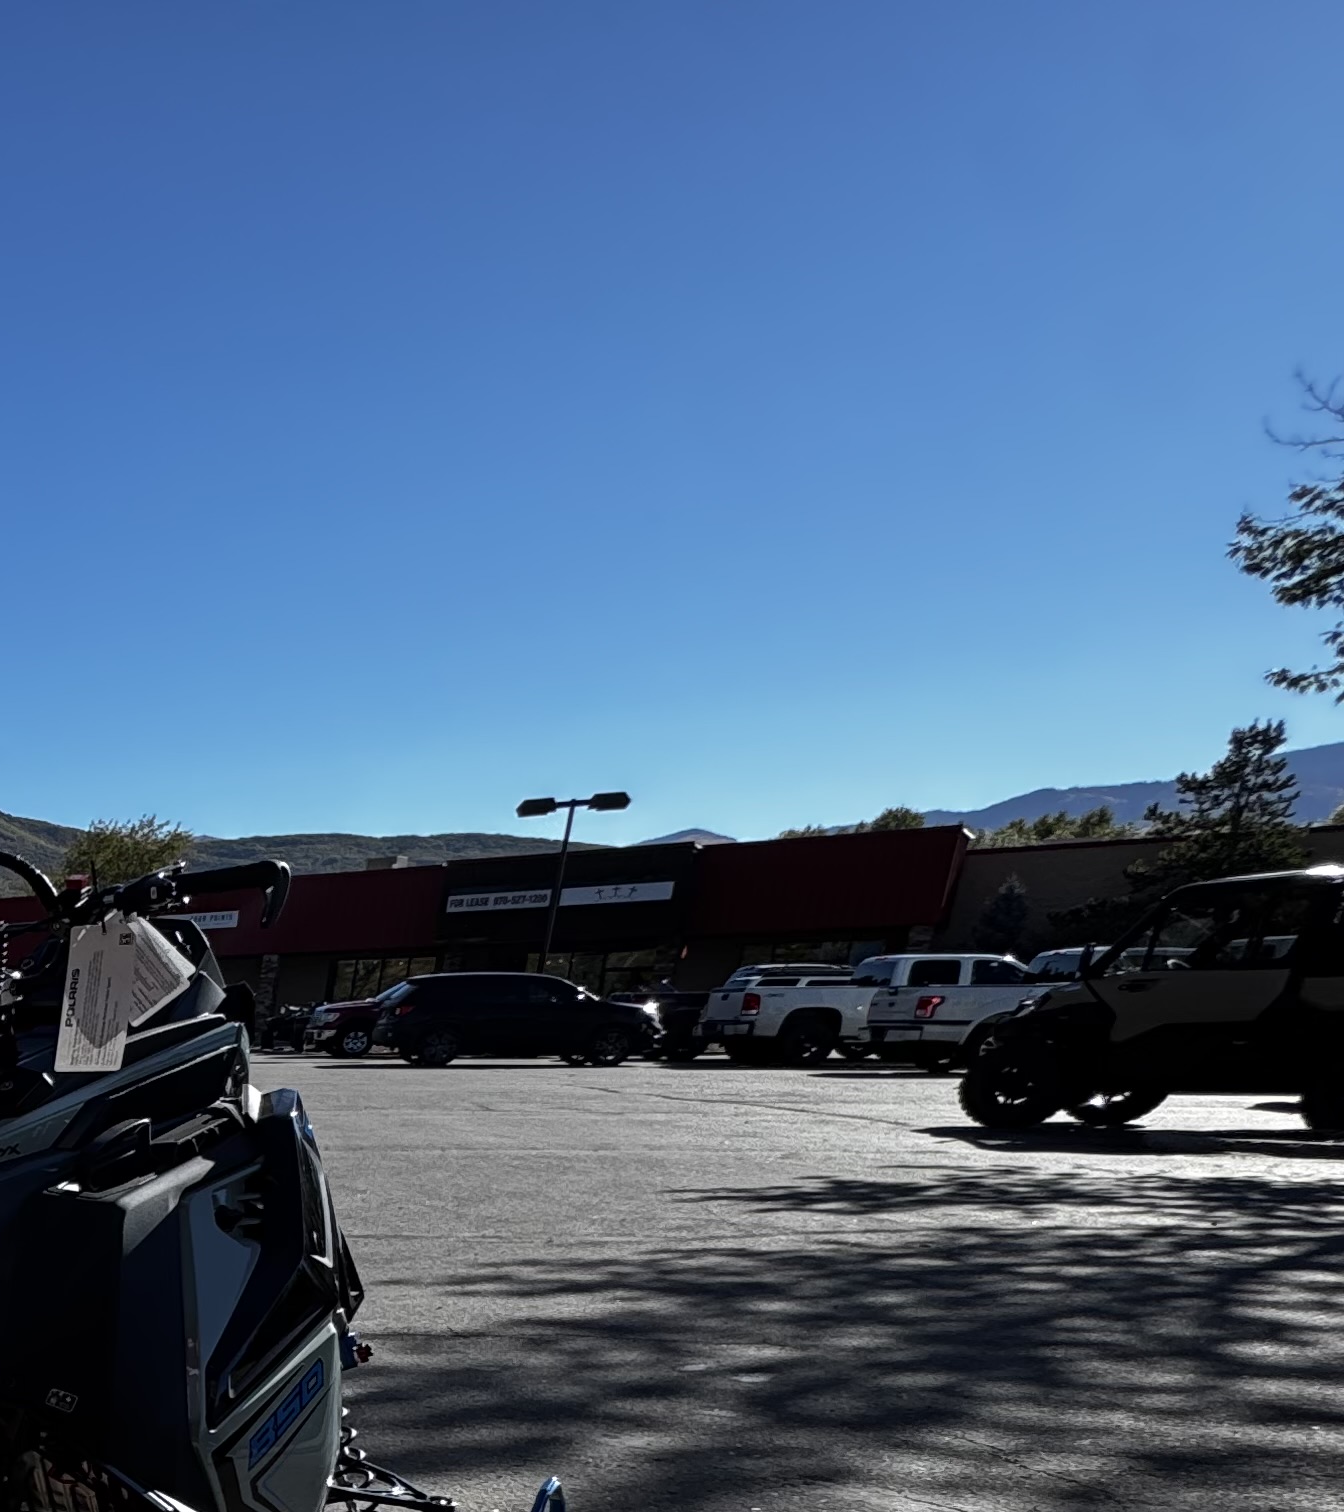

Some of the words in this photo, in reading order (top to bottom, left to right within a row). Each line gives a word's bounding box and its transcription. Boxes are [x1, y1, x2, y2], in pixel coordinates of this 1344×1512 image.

[449, 898, 465, 909] FOR
[466, 897, 490, 907] LEASE
[64, 968, 80, 1028] POLARIS
[247, 1357, 325, 1472] 850
